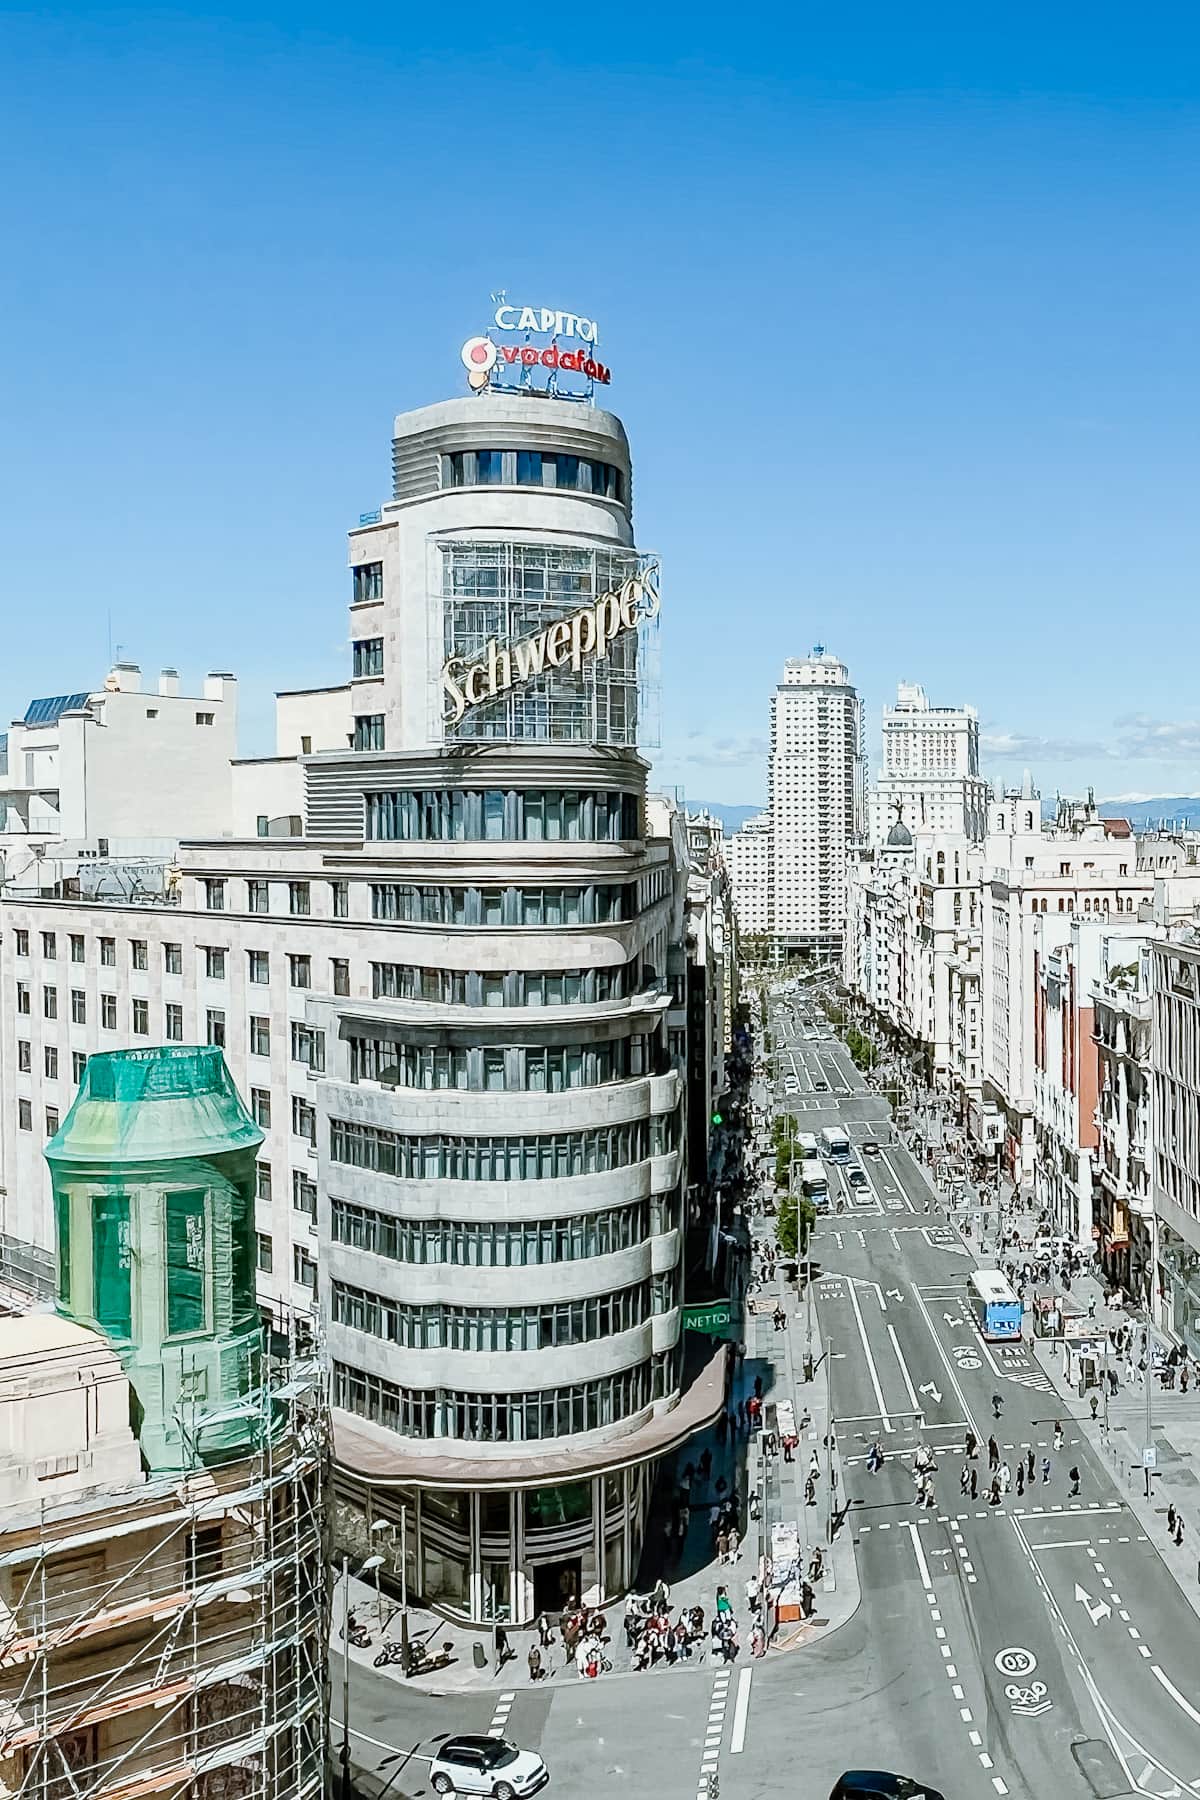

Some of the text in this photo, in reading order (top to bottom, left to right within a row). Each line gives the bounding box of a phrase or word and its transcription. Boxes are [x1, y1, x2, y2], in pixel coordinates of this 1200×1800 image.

[501, 344, 612, 384] vodafon
[440, 559, 661, 725] Schweppes
[995, 1347, 1026, 1357] TAXI
